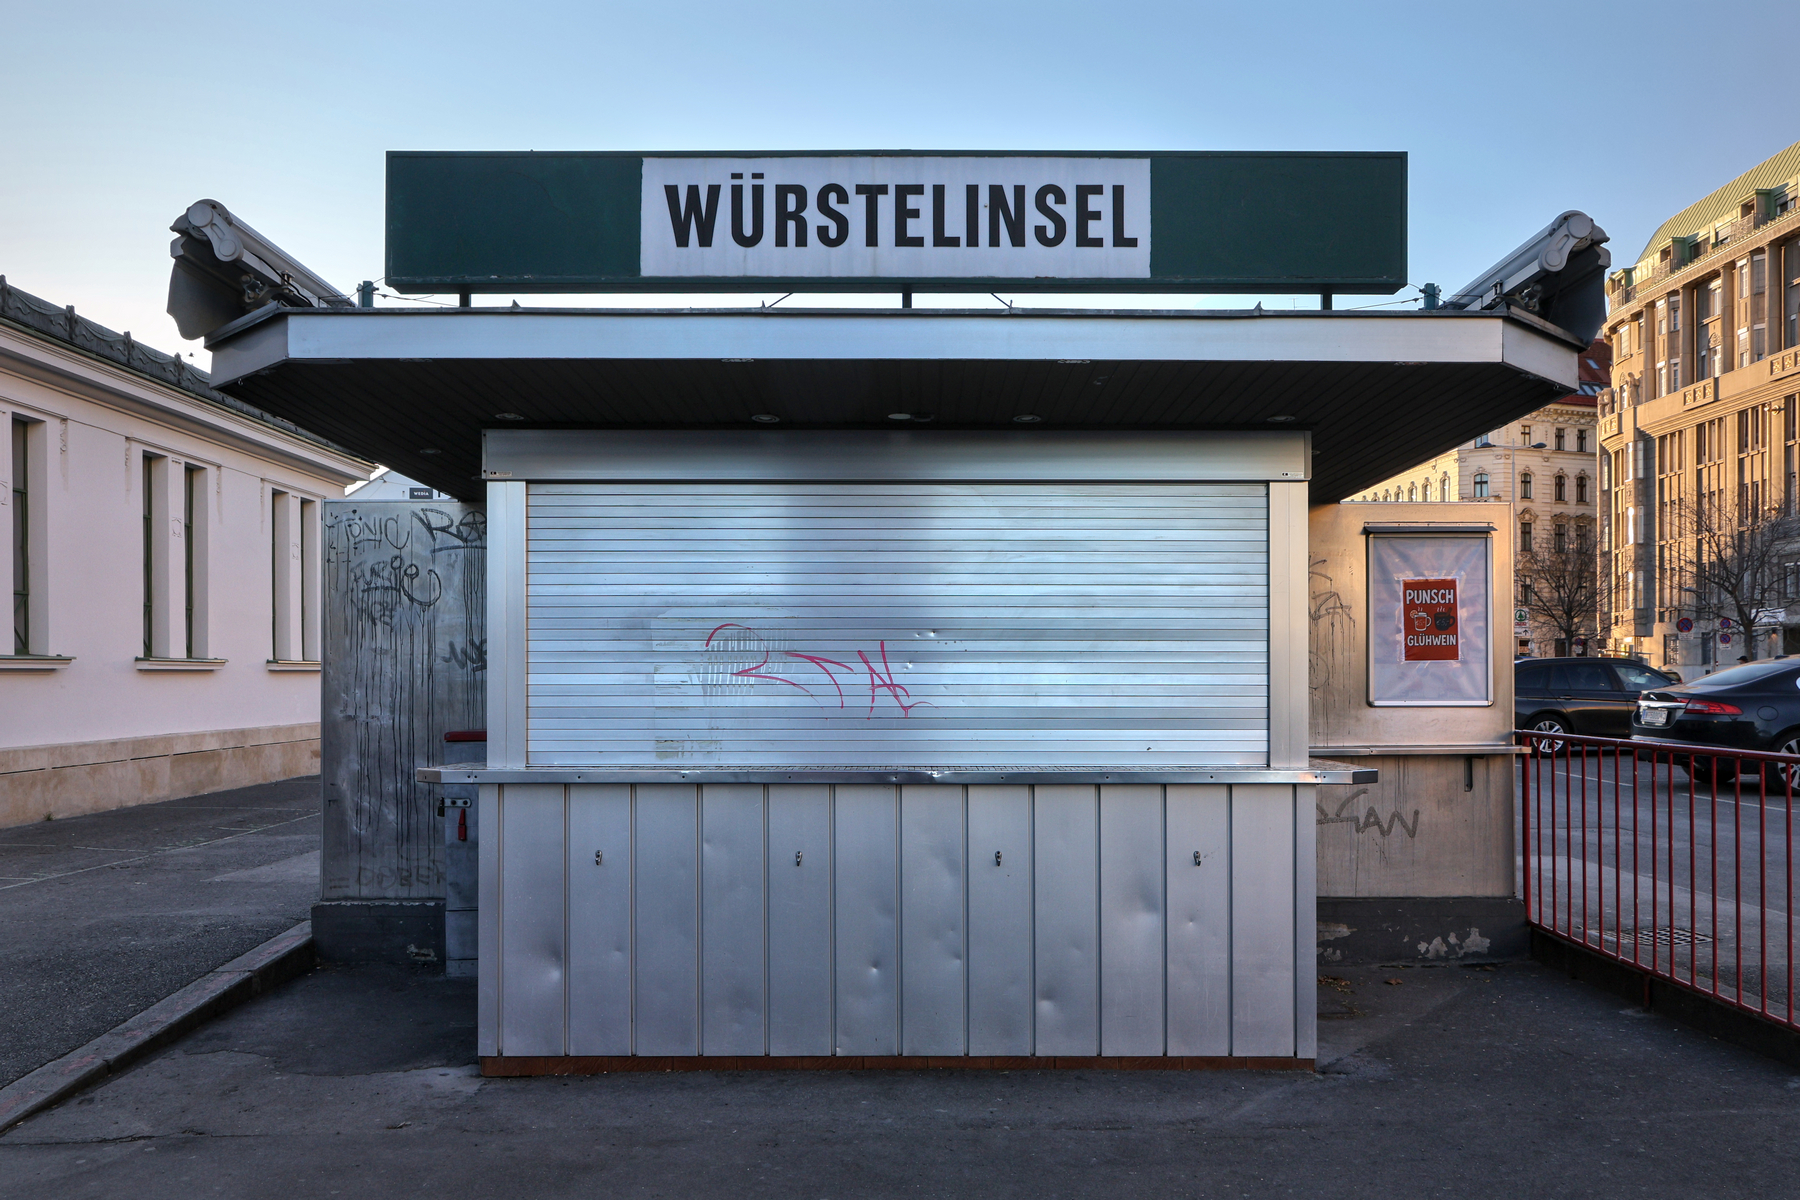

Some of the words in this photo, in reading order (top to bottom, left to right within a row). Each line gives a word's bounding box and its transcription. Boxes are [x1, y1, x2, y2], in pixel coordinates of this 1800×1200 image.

[665, 172, 1138, 248] WÜRSTELINSEL
[1405, 589, 1454, 605] PUNSCH
[1407, 633, 1457, 646] GLÜHWEIN
